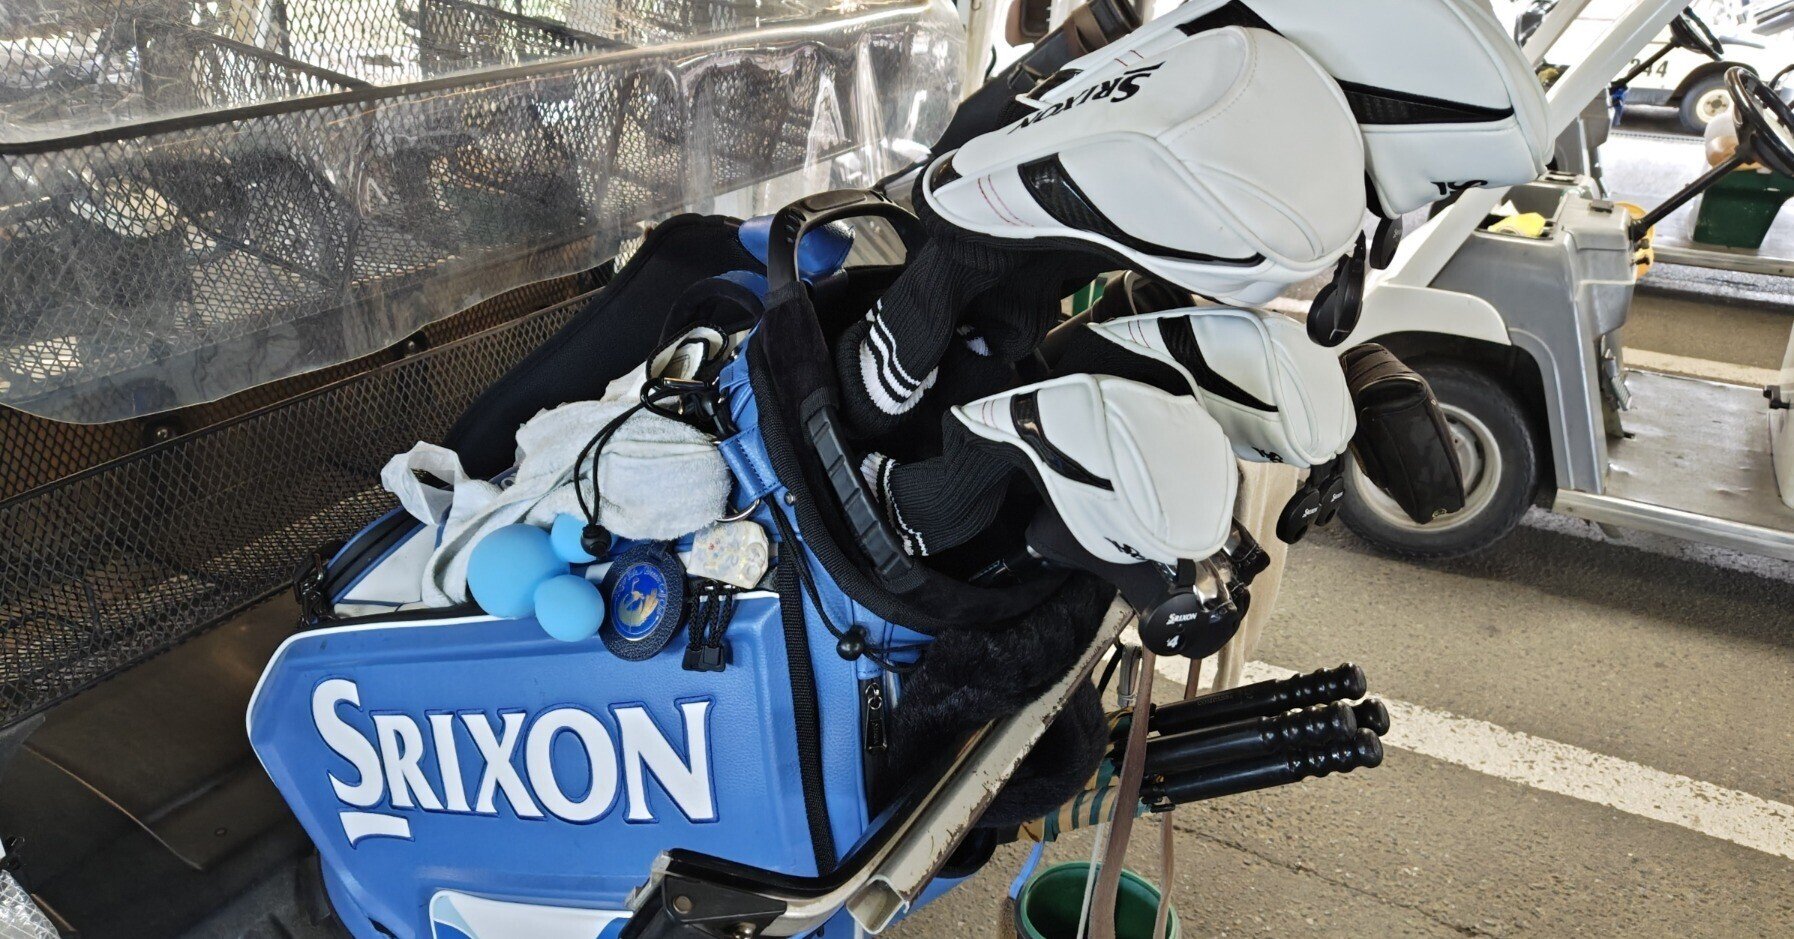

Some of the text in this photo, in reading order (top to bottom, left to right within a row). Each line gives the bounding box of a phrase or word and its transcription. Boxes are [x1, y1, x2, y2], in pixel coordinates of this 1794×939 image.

[1008, 61, 1166, 135] SRIXON
[1166, 612, 1198, 626] SRIXON
[1167, 635, 1180, 648] 4
[310, 677, 717, 848] SRIXON
